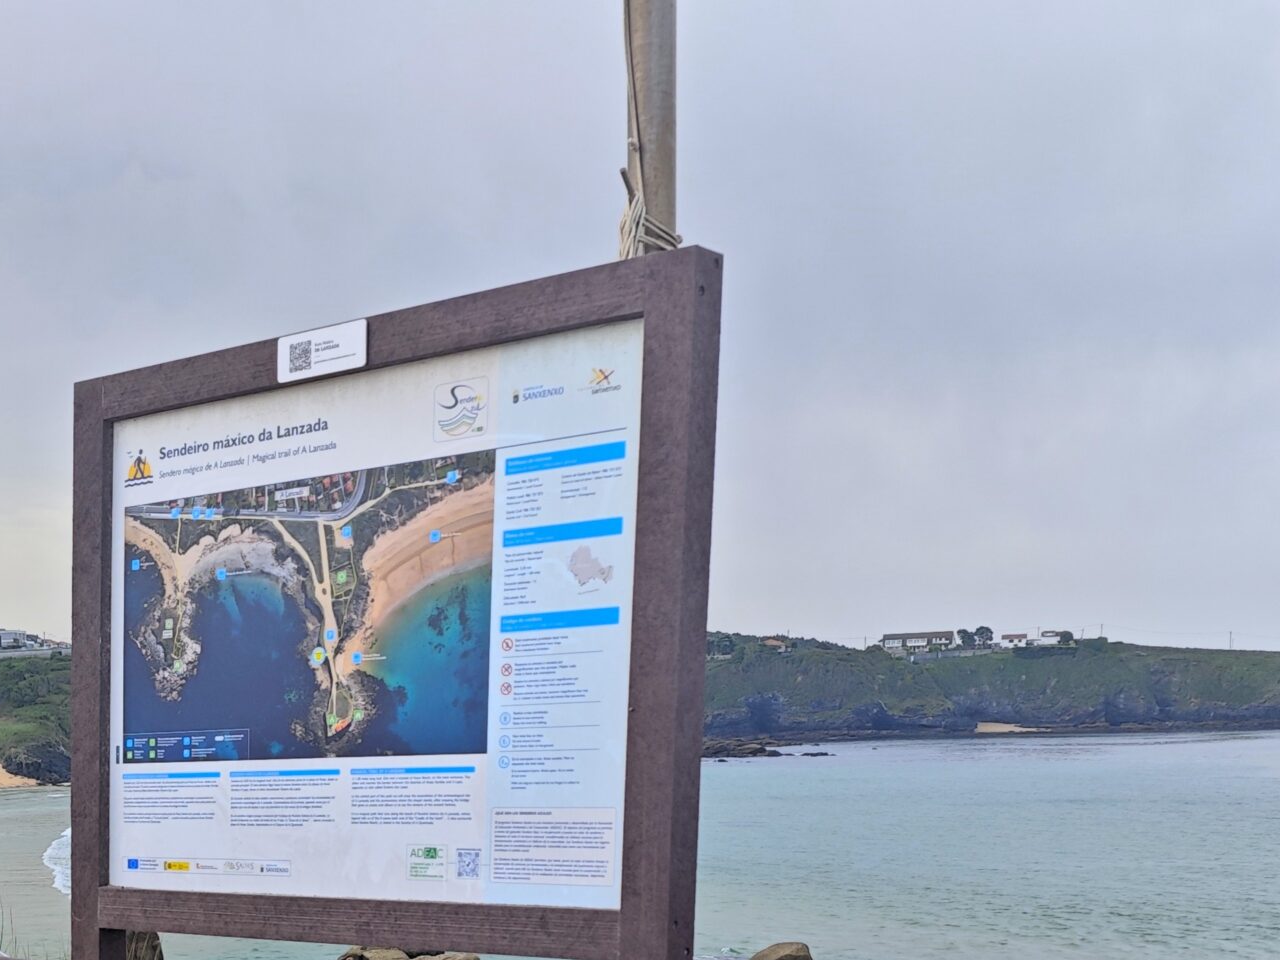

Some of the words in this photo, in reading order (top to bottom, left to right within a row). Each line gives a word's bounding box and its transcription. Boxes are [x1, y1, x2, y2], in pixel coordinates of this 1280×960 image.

[522, 386, 565, 401] SANXENXO
[159, 442, 209, 460] Sendeiro
[212, 431, 255, 452] máxico
[258, 426, 273, 442] da
[276, 417, 329, 439] Lanzada
[159, 465, 182, 479] Sendero
[183, 462, 203, 476] mágico
[204, 461, 213, 471] de
[213, 461, 219, 469] A
[219, 457, 245, 469] Lanzada
[252, 451, 277, 464] Magical
[277, 448, 292, 460] trail
[293, 446, 301, 457] of
[301, 445, 308, 454] A
[308, 440, 337, 453] Lanzada
[409, 847, 444, 860] ADEAC
